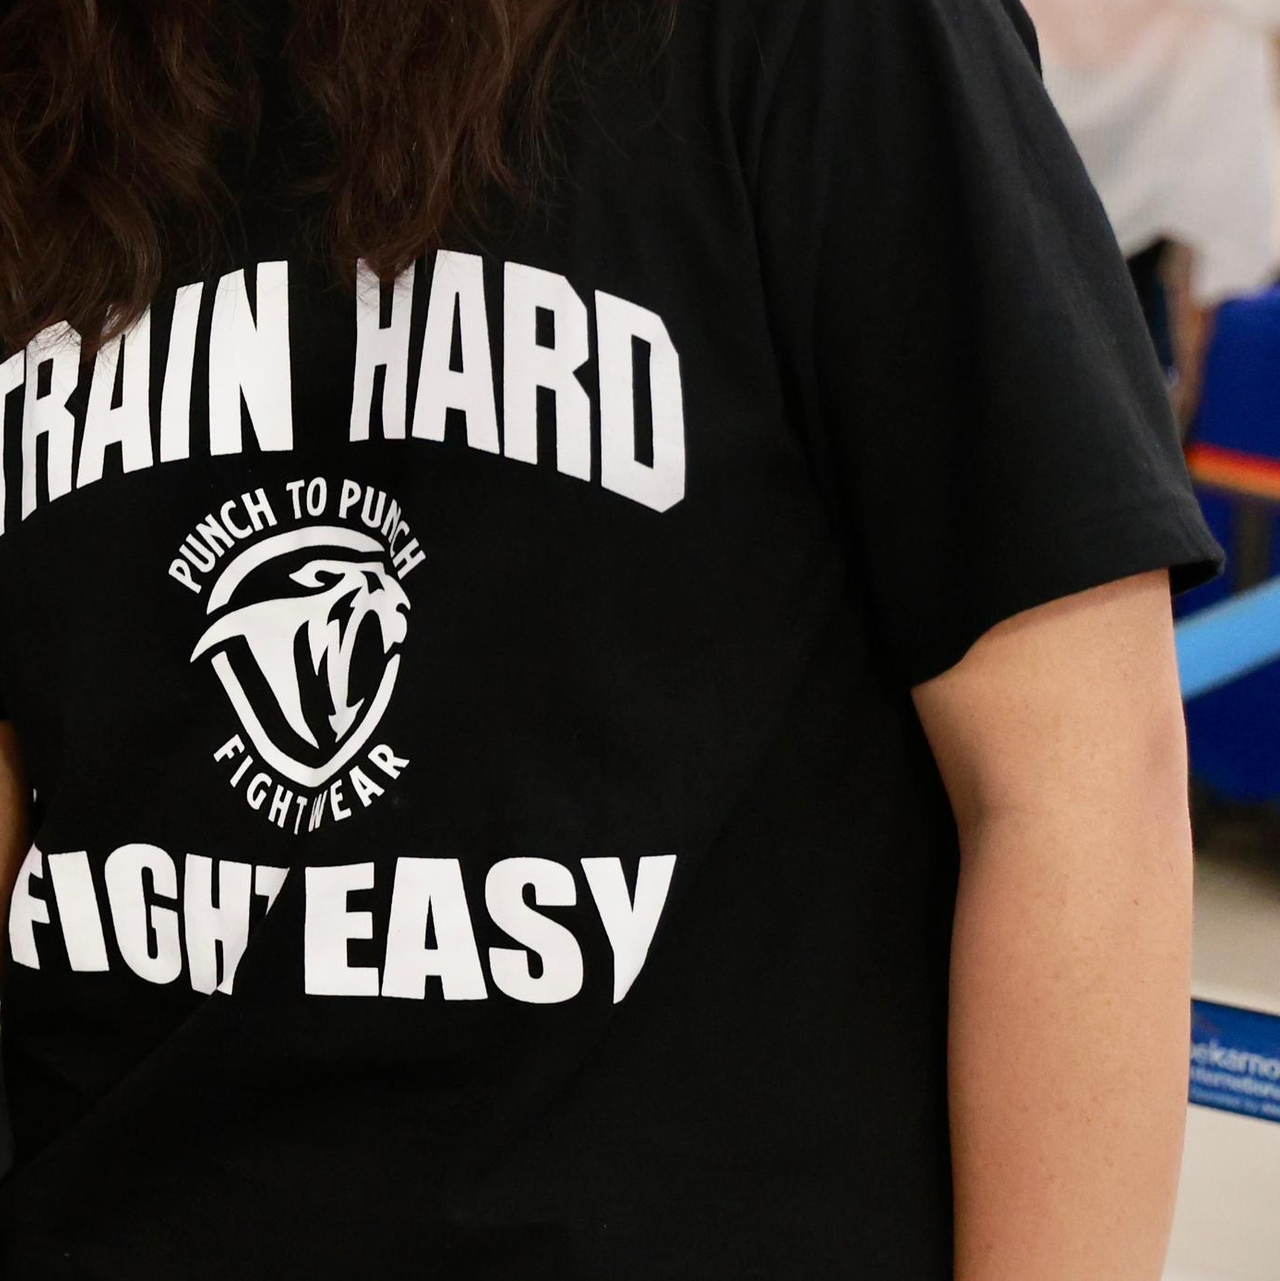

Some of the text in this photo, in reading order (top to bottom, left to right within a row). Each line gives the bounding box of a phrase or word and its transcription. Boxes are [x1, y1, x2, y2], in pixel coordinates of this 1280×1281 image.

[349, 249, 686, 513] HARD
[168, 476, 426, 594] PUNCH TO PUNCH
[213, 733, 411, 835] FIGHTWEAR
[304, 854, 678, 1005] EASY
